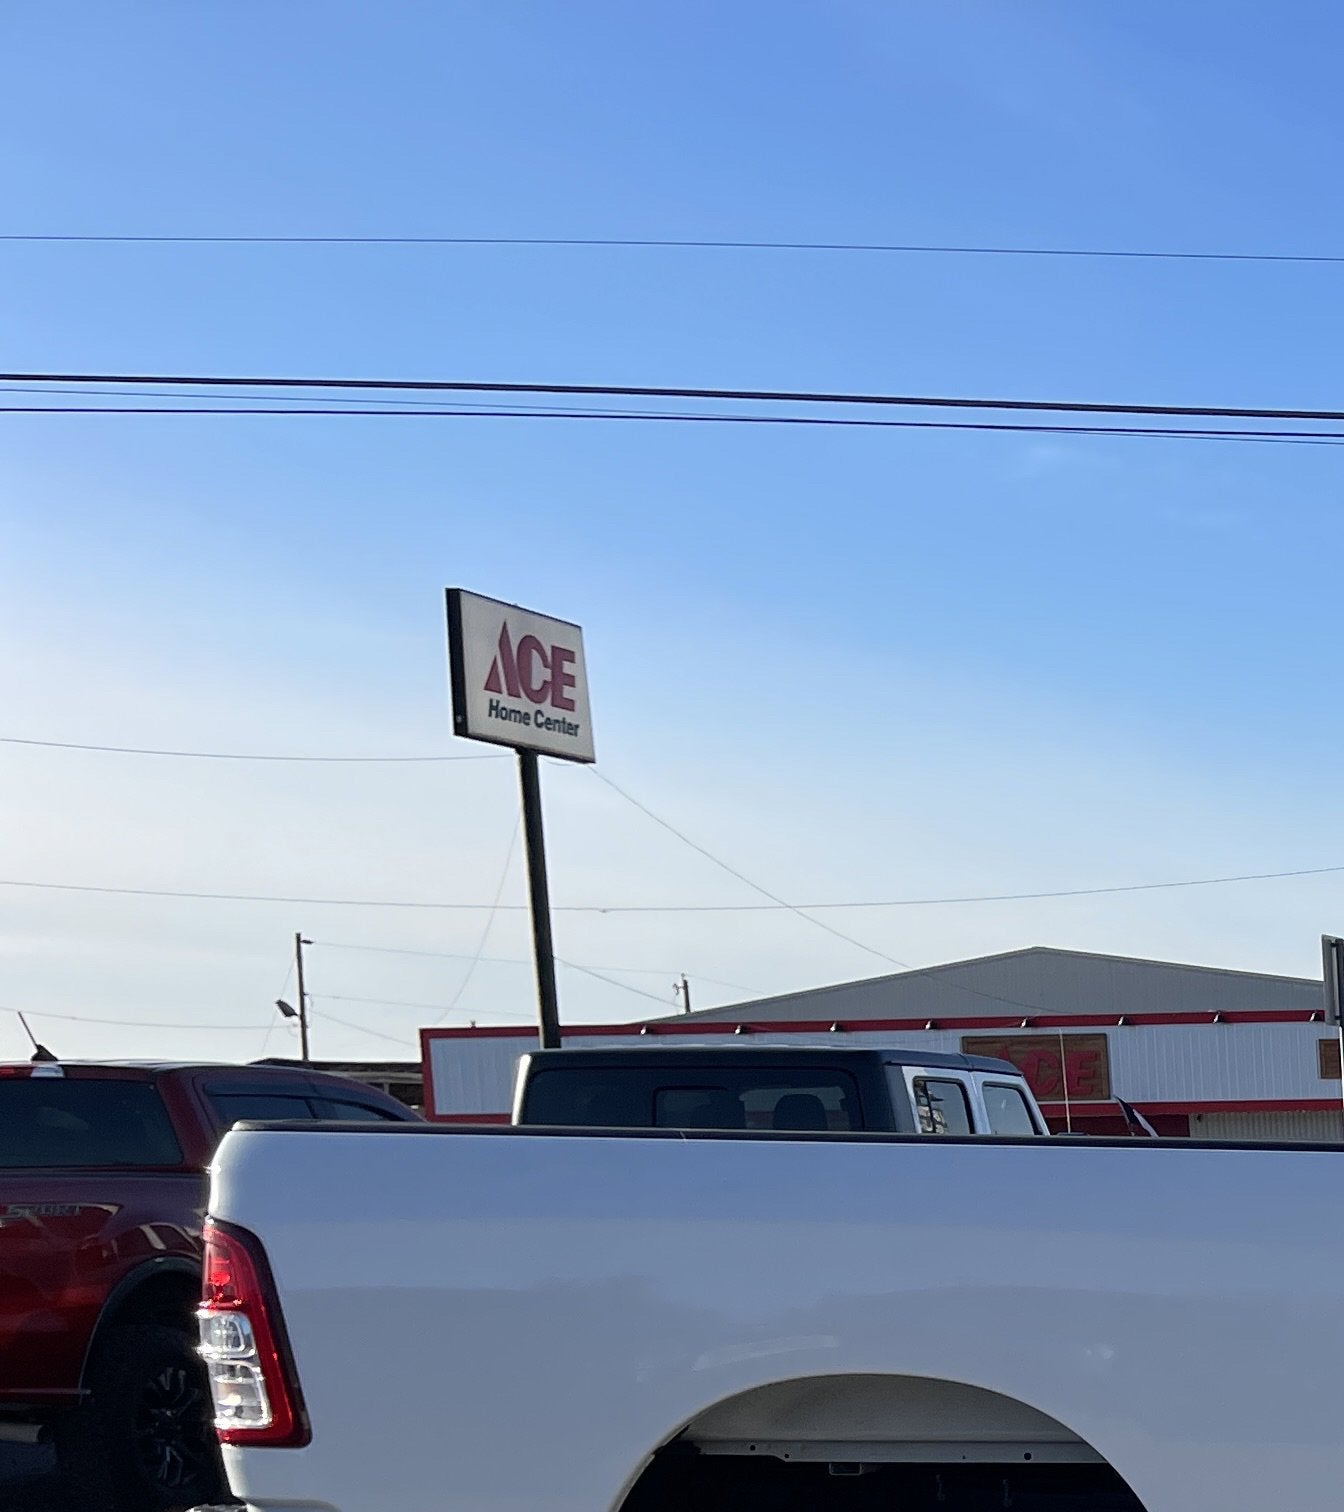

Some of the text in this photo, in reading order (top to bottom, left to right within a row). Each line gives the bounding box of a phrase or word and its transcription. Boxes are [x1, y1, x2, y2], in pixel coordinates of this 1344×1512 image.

[484, 620, 577, 712] ACE
[488, 698, 580, 737] Home Center
[998, 1044, 1098, 1097] CE
